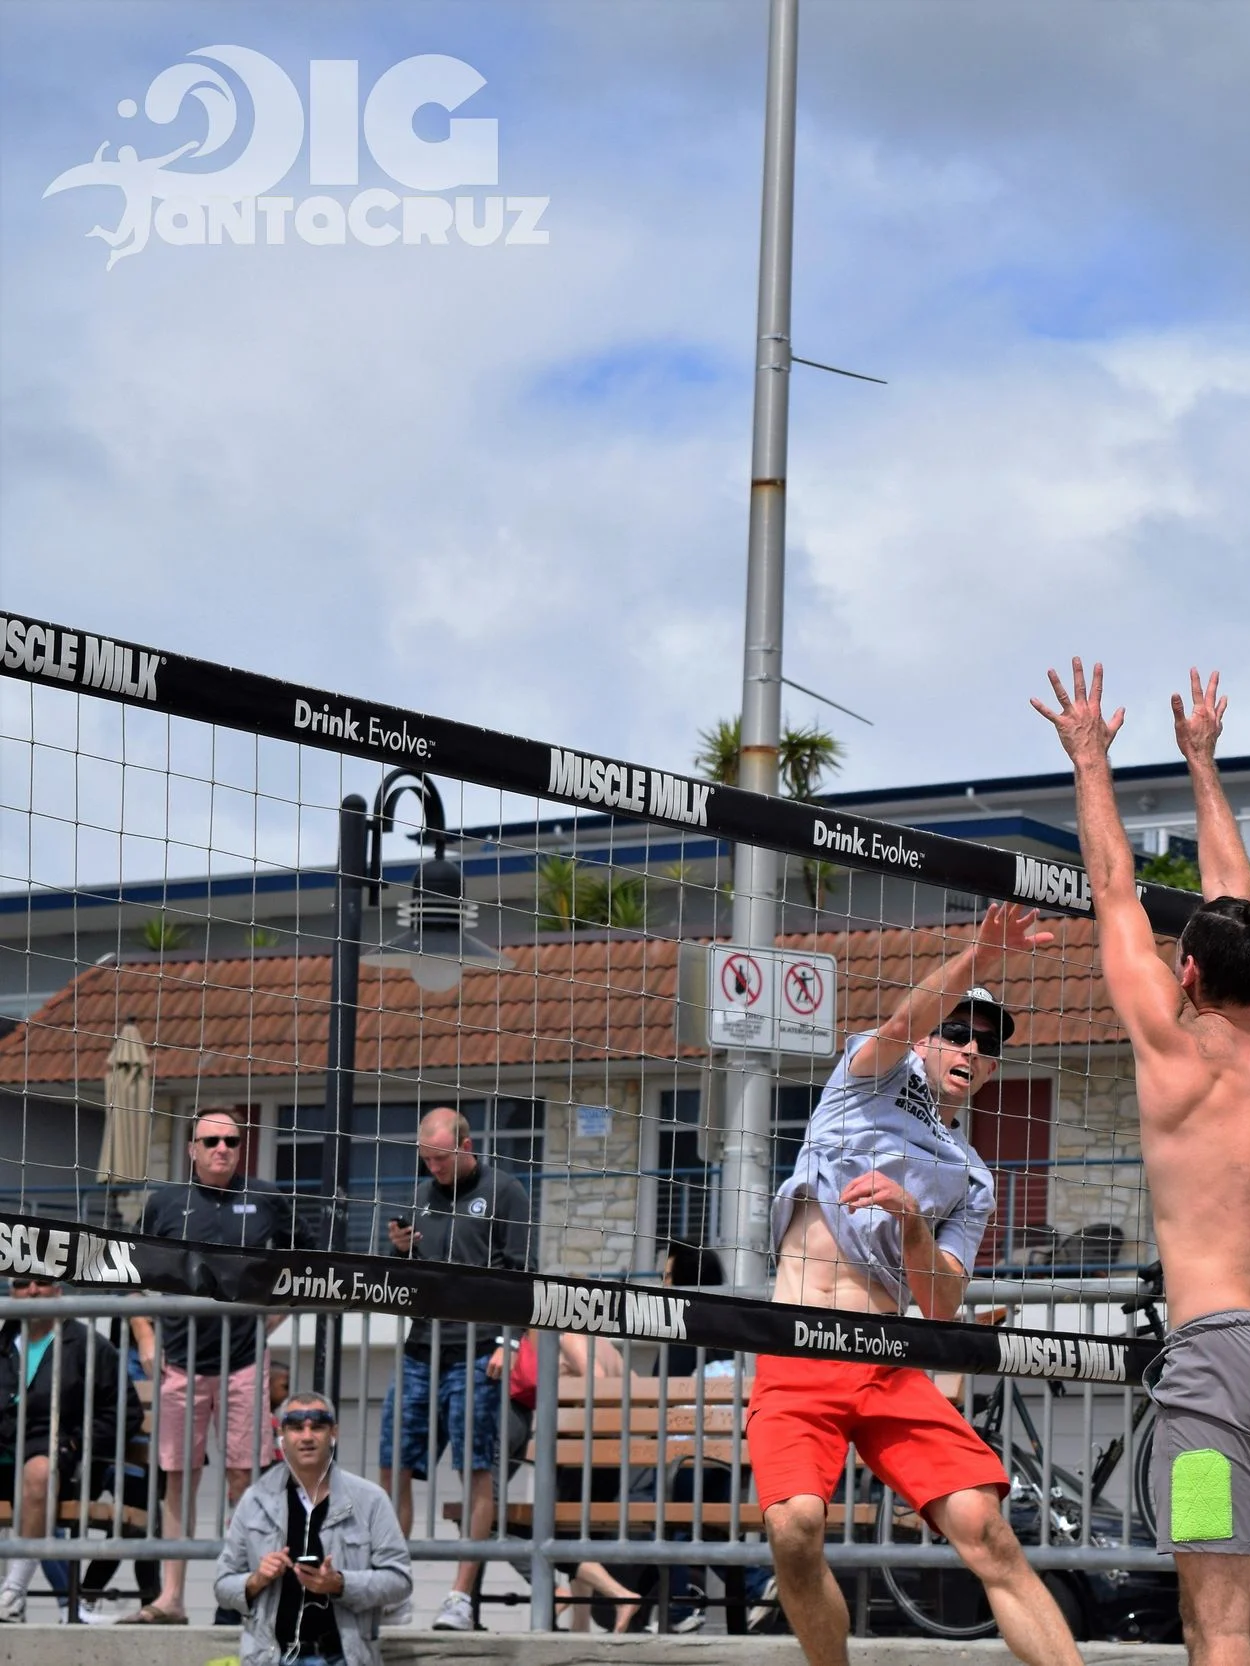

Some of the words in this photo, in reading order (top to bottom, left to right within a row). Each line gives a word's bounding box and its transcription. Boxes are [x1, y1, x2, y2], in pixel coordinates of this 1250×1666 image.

[0, 617, 78, 682] SCLE
[82, 635, 160, 701] MILK
[295, 699, 364, 743] Drink.
[368, 716, 432, 758] Evolve.
[548, 748, 646, 813] MUSCLE
[649, 771, 710, 827] MILK
[813, 820, 868, 857] Drink.
[872, 833, 922, 869] Evolve.
[1013, 855, 1092, 911] MUSCLE
[0, 1222, 70, 1278] SCLE
[272, 1266, 347, 1300] Drink.
[625, 1290, 687, 1340] MILK
[795, 1320, 851, 1353] Drink.
[854, 1327, 906, 1358] Evolve.
[997, 1332, 1077, 1378] MUSCLE
[1077, 1339, 1126, 1382] MILK
